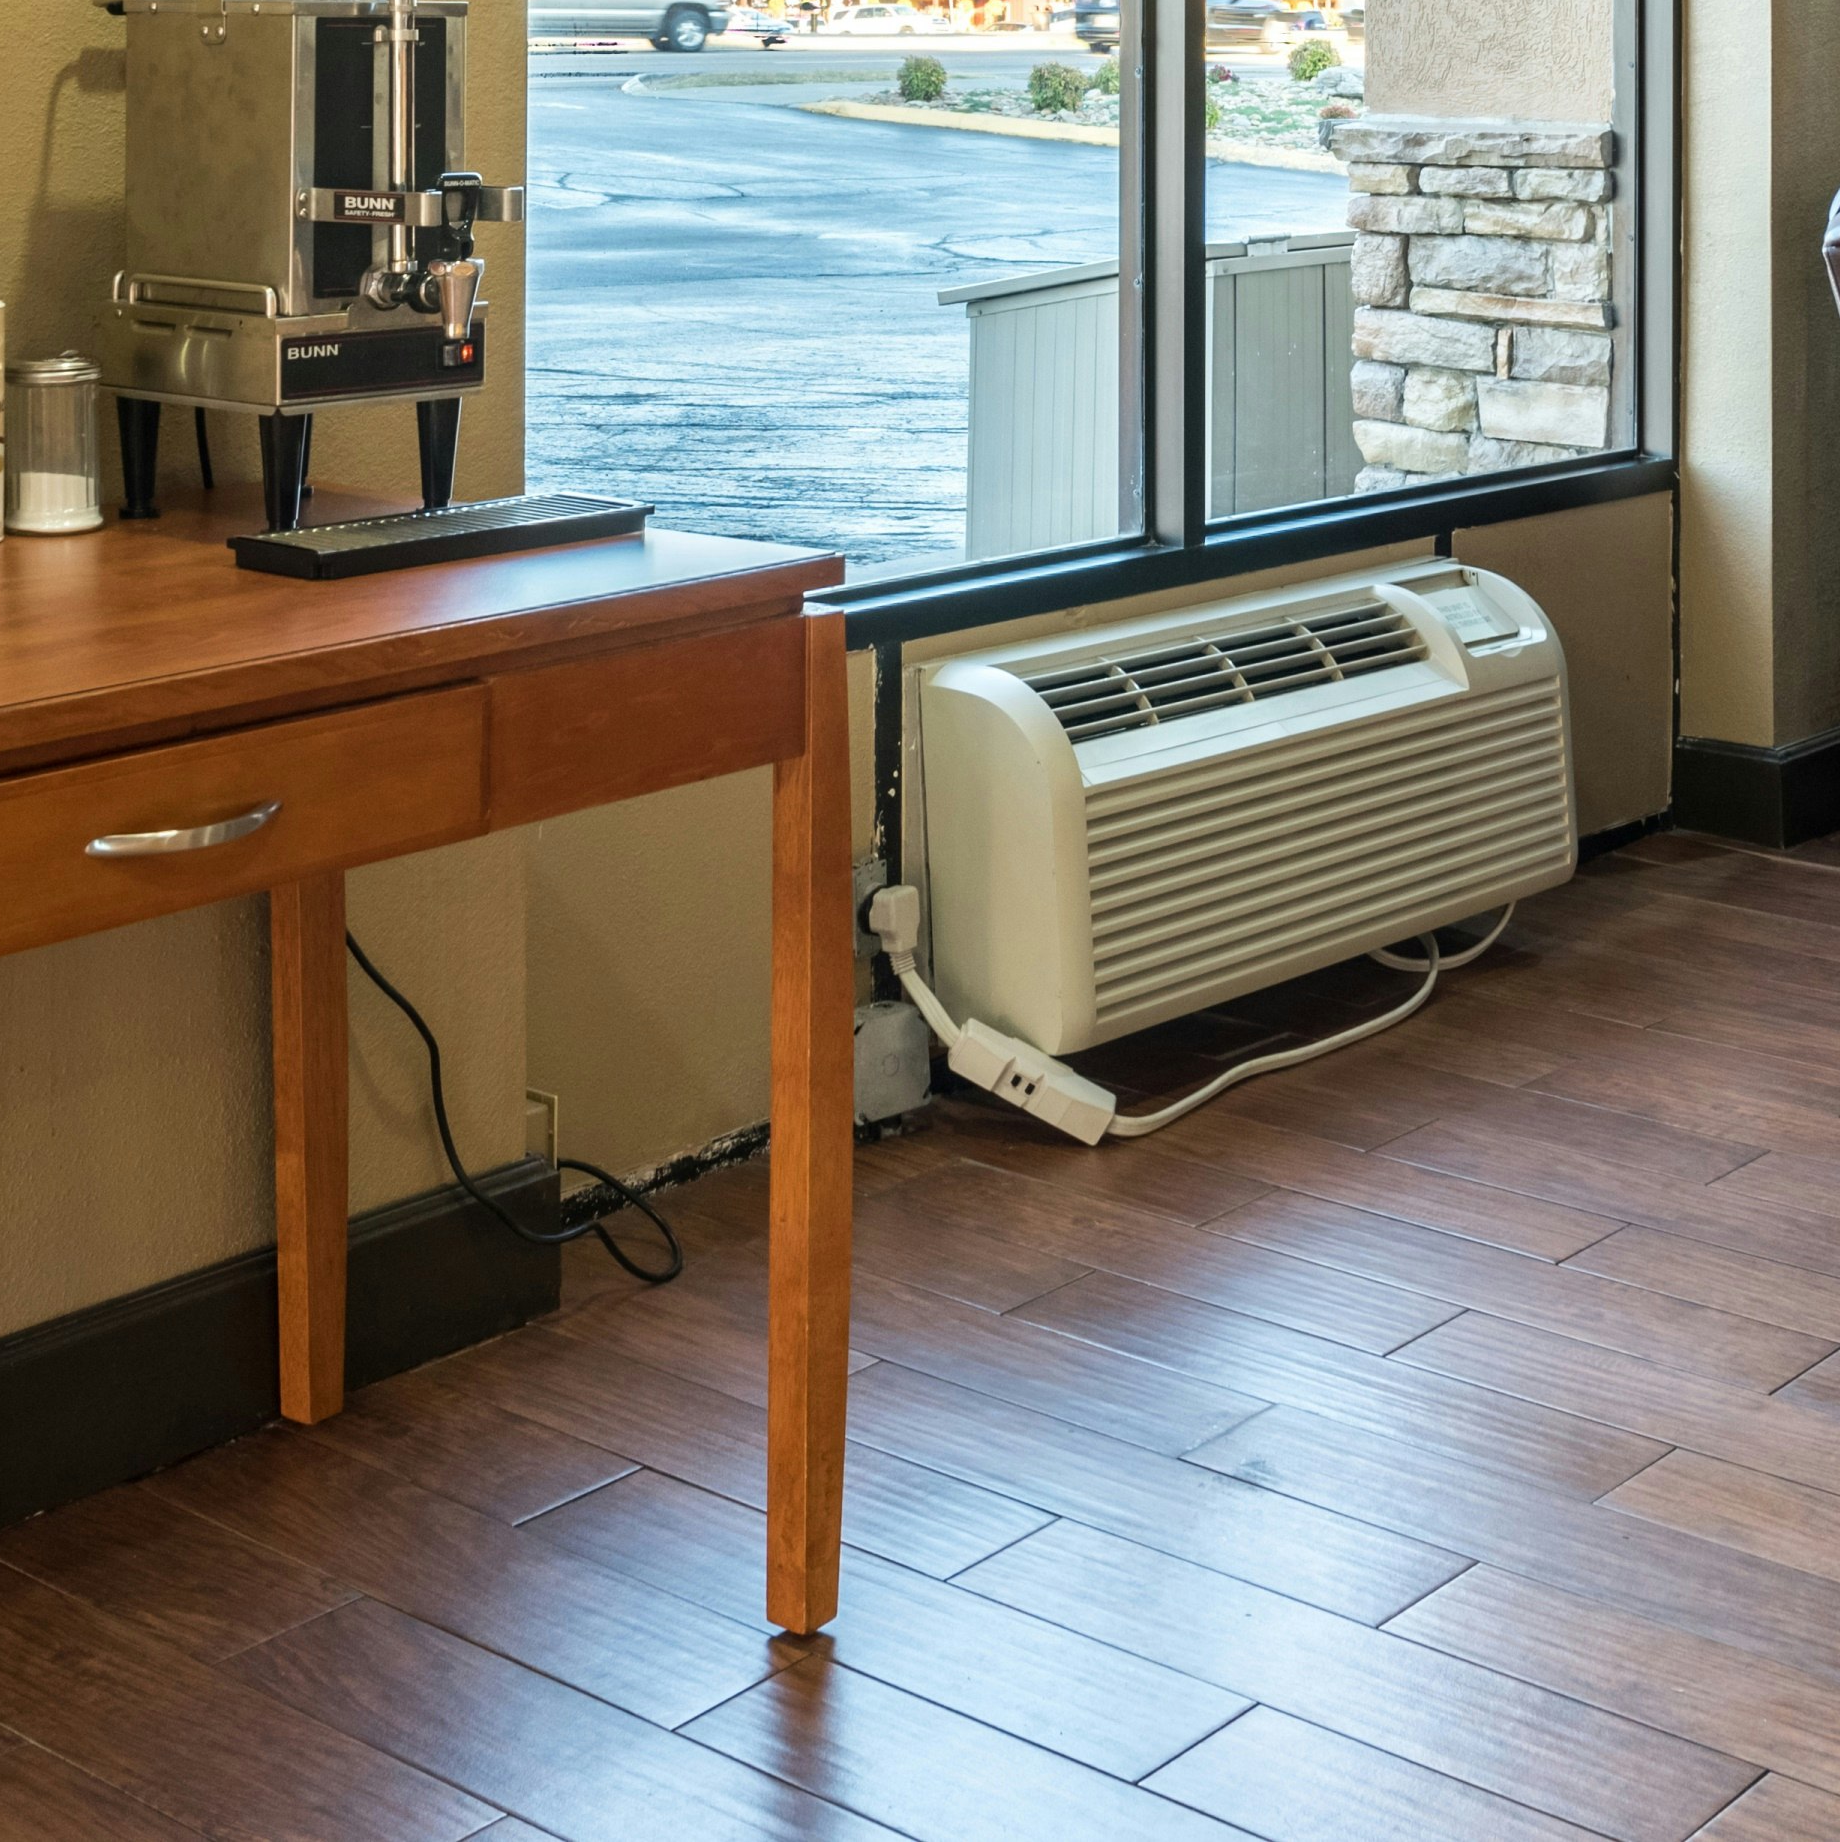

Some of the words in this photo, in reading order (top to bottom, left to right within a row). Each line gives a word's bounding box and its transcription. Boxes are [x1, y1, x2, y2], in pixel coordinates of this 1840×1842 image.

[344, 196, 394, 211] BUNN
[344, 209, 395, 218] SAFETY-FRESH
[287, 343, 340, 360] BUNN
